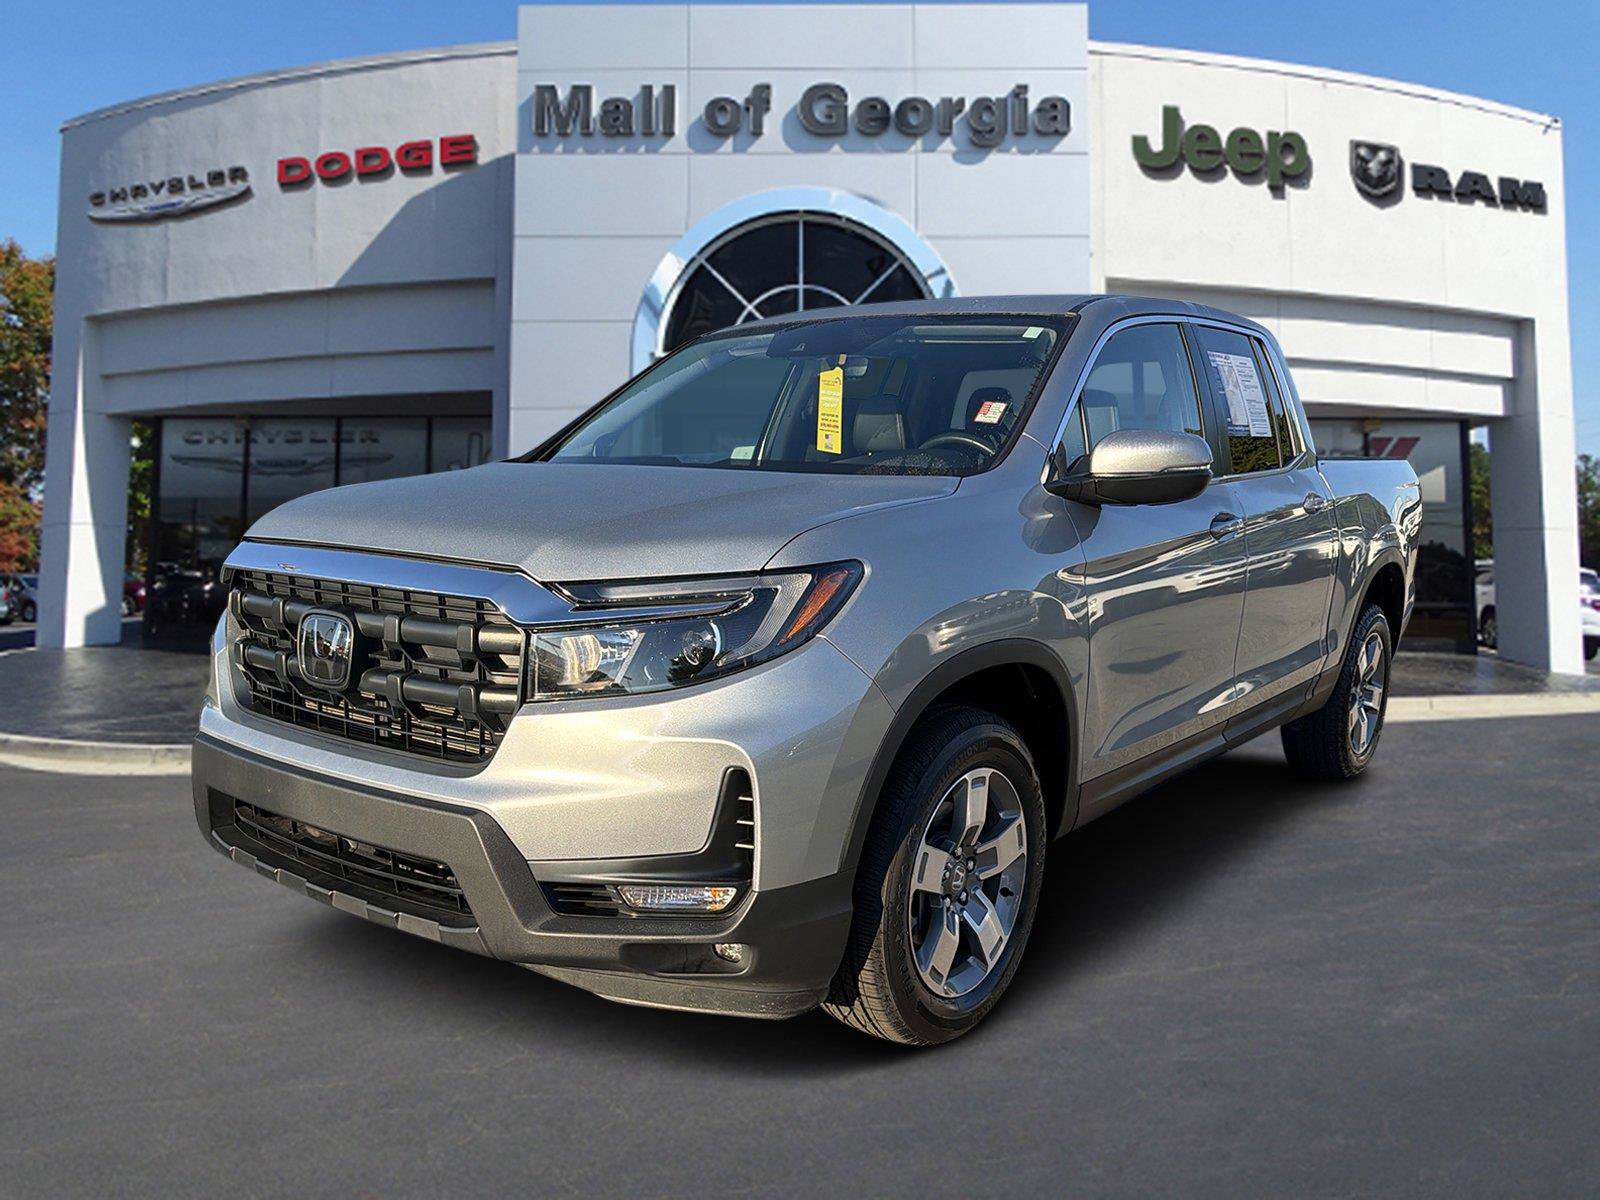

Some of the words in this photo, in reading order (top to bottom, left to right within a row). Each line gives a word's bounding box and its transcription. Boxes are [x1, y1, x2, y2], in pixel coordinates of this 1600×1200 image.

[532, 84, 677, 137] Mall
[704, 83, 772, 136] of
[799, 83, 1073, 148] Georgia
[276, 134, 477, 188] DODGE
[1131, 105, 1309, 190] Jeep
[88, 165, 251, 207] CHRYSLER
[1411, 163, 1547, 214] RAM
[182, 429, 382, 445] CHRYSLER
